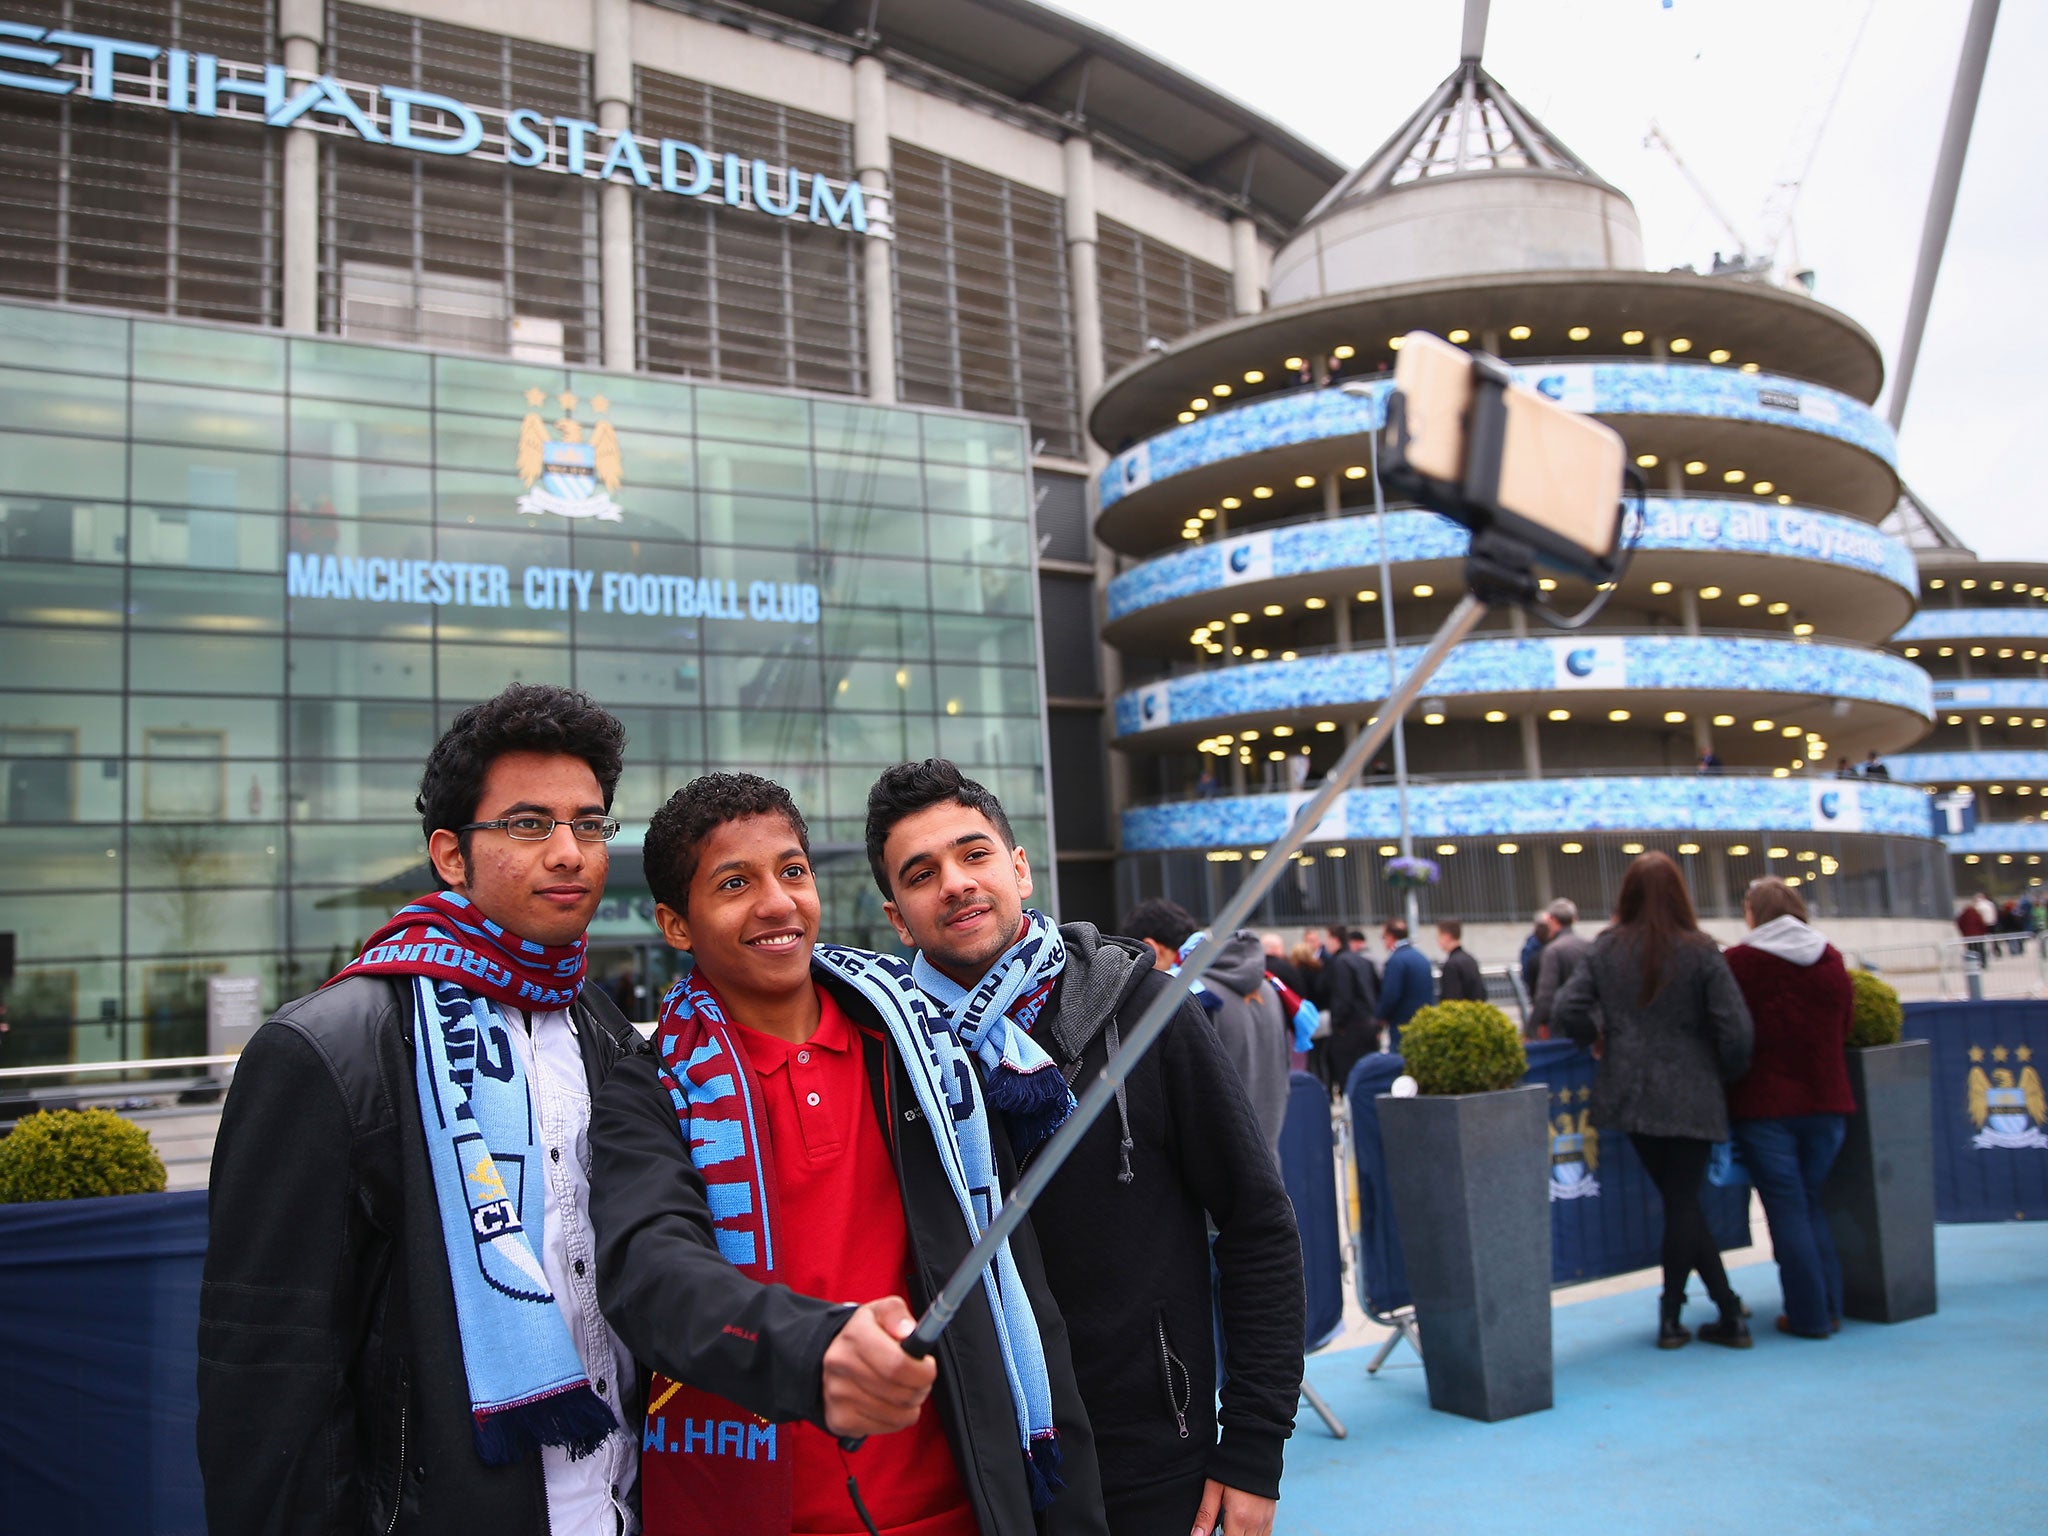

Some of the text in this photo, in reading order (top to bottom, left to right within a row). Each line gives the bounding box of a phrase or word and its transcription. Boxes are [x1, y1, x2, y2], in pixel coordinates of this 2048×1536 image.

[0, 20, 867, 234] ETIHAD STADIUM
[1656, 510, 1721, 541] are
[1730, 508, 1769, 543] all
[1778, 510, 1885, 567] Cityzens
[287, 552, 821, 624] MANCHESTER CITY FOOTBALL CLUB
[361, 942, 512, 988] GROUND
[643, 1415, 777, 1462] W.HAM
